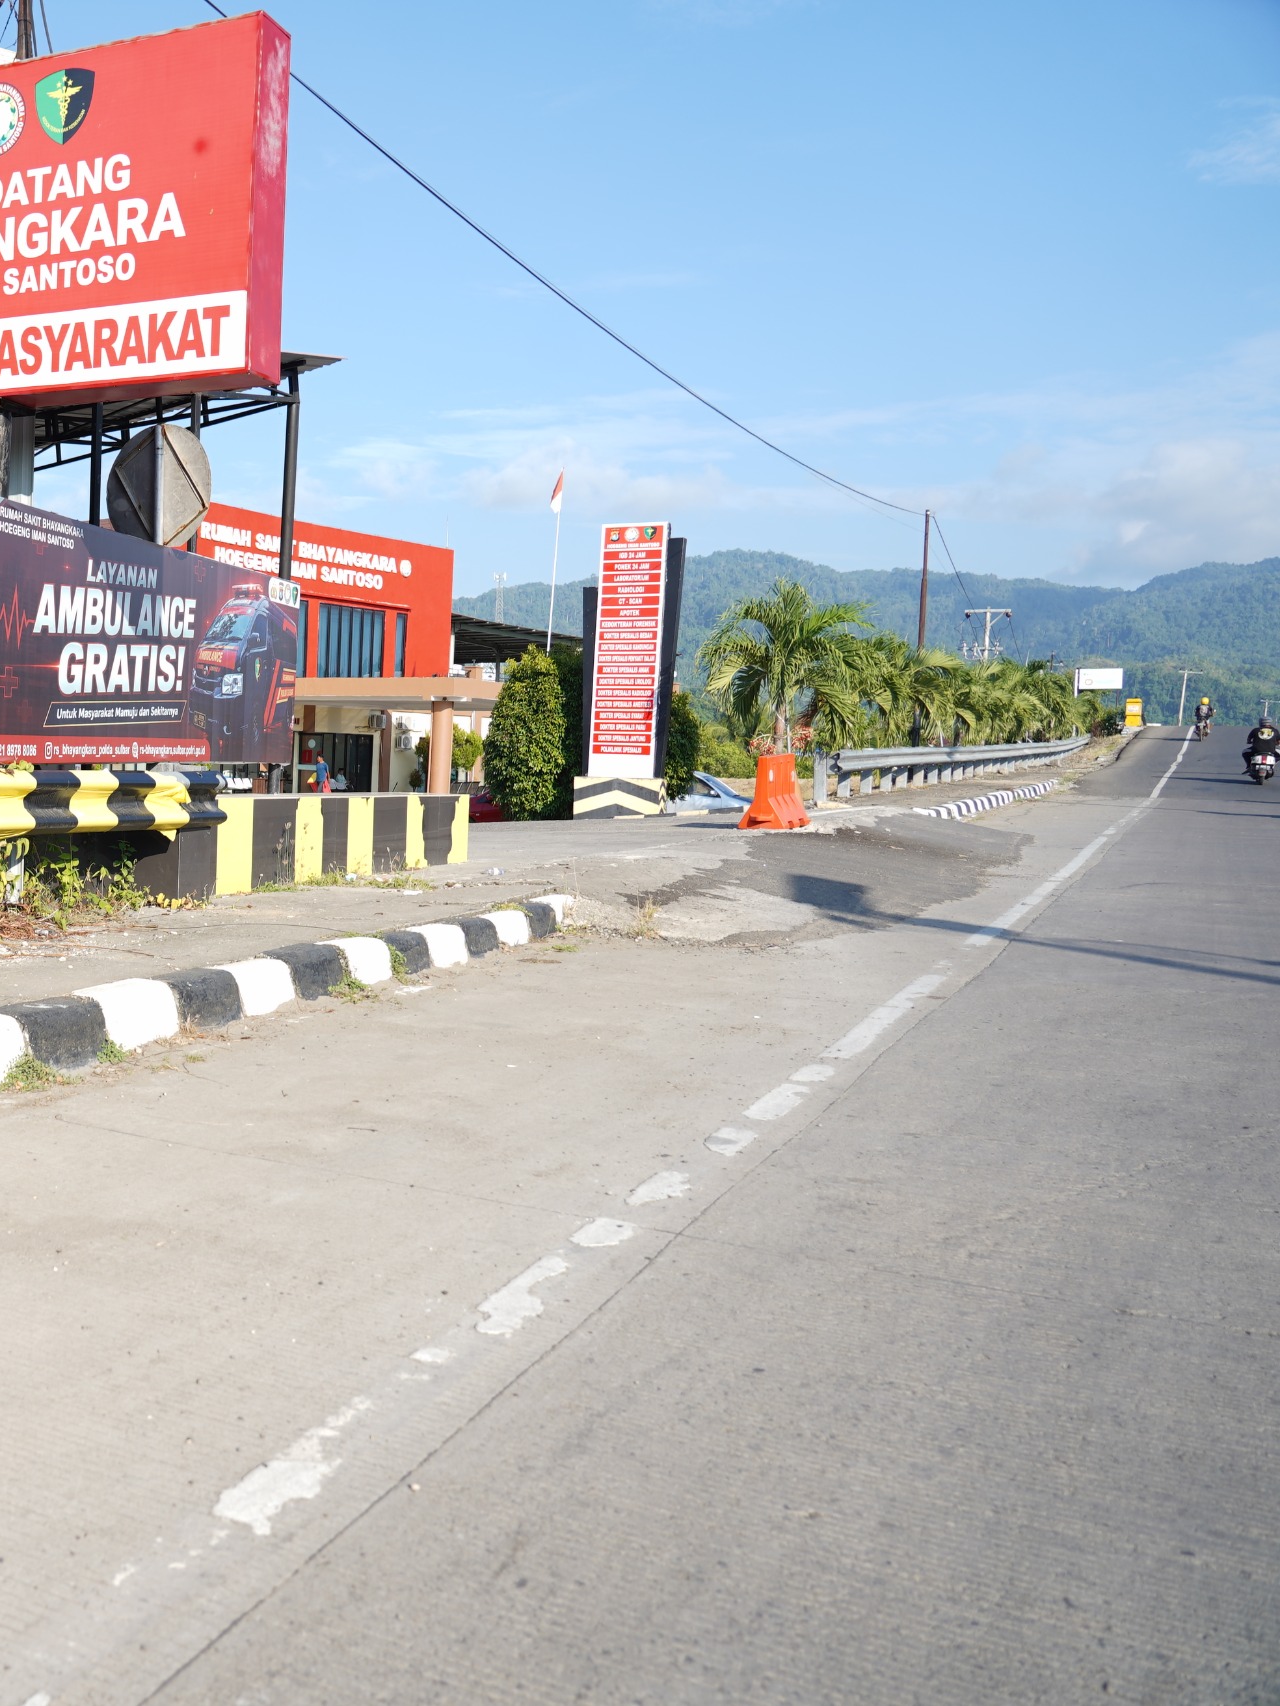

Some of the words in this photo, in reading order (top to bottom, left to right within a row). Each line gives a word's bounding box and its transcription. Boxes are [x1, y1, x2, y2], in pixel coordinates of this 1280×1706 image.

[2, 253, 135, 300] SANTOSO
[0, 506, 23, 521] RUMAH
[24, 513, 41, 527] SAKIT
[42, 518, 84, 538] BHAYANGKARA
[0, 521, 30, 538] HOEGENG
[31, 529, 47, 542] IMAN
[47, 534, 74, 549] SANTOSO
[201, 521, 251, 547] RUMAH
[298, 541, 398, 574] BHAYANGKARA
[86, 559, 158, 589] LAYANAN
[291, 560, 318, 581] MAN
[320, 565, 383, 590] SANTOSO
[33, 584, 197, 638] AMBULANCE
[57, 642, 185, 695] GRATIS!
[56, 708, 77, 719] Untuk
[78, 707, 114, 720] Masyarakat
[115, 707, 138, 719] Mamuju
[138, 707, 150, 717] dan
[150, 706, 178, 719] Sekitarnya
[6, 744, 21, 757] 8978
